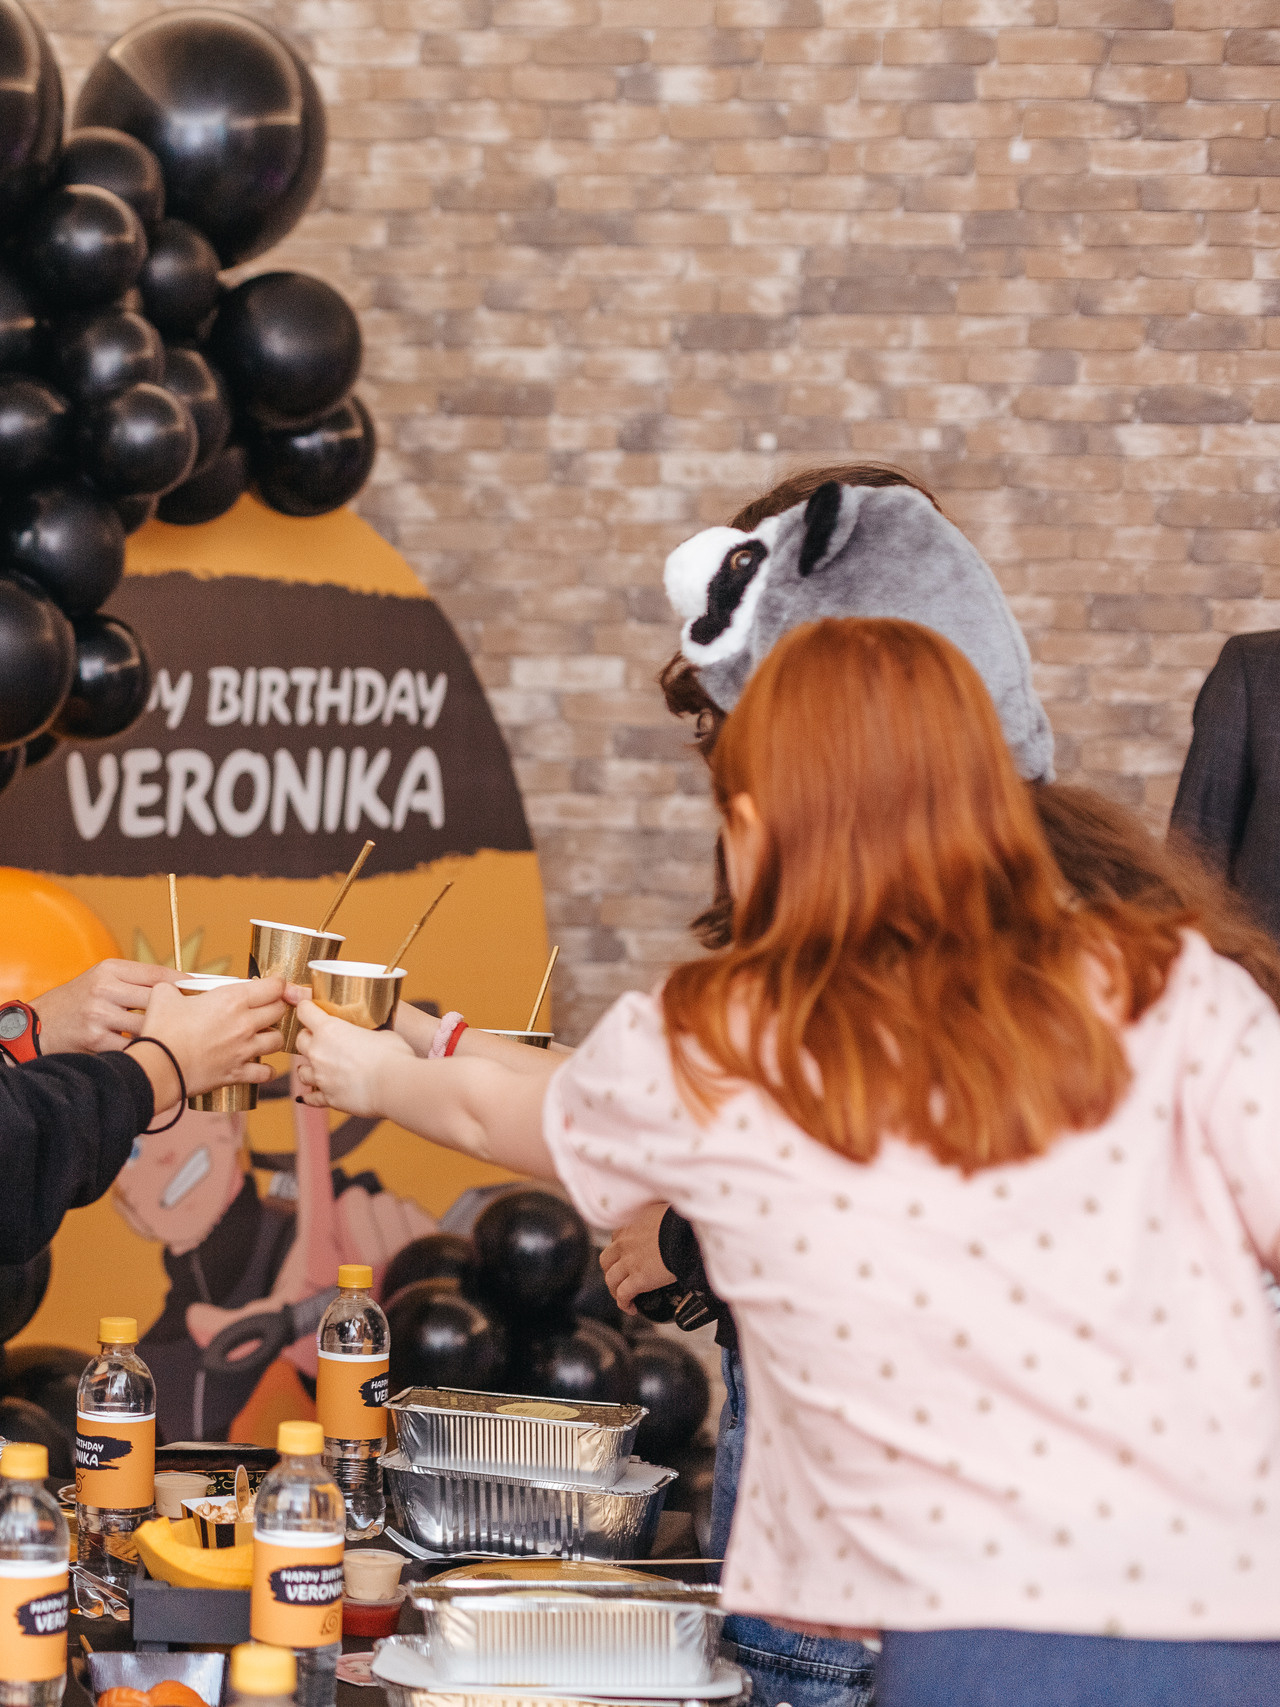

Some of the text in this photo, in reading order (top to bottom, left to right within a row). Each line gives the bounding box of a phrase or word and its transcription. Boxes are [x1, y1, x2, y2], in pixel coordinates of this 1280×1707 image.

[207, 666, 448, 728] BIRTHDAY
[66, 746, 445, 841] VERONIKA
[281, 1570, 320, 1584] HAPPY
